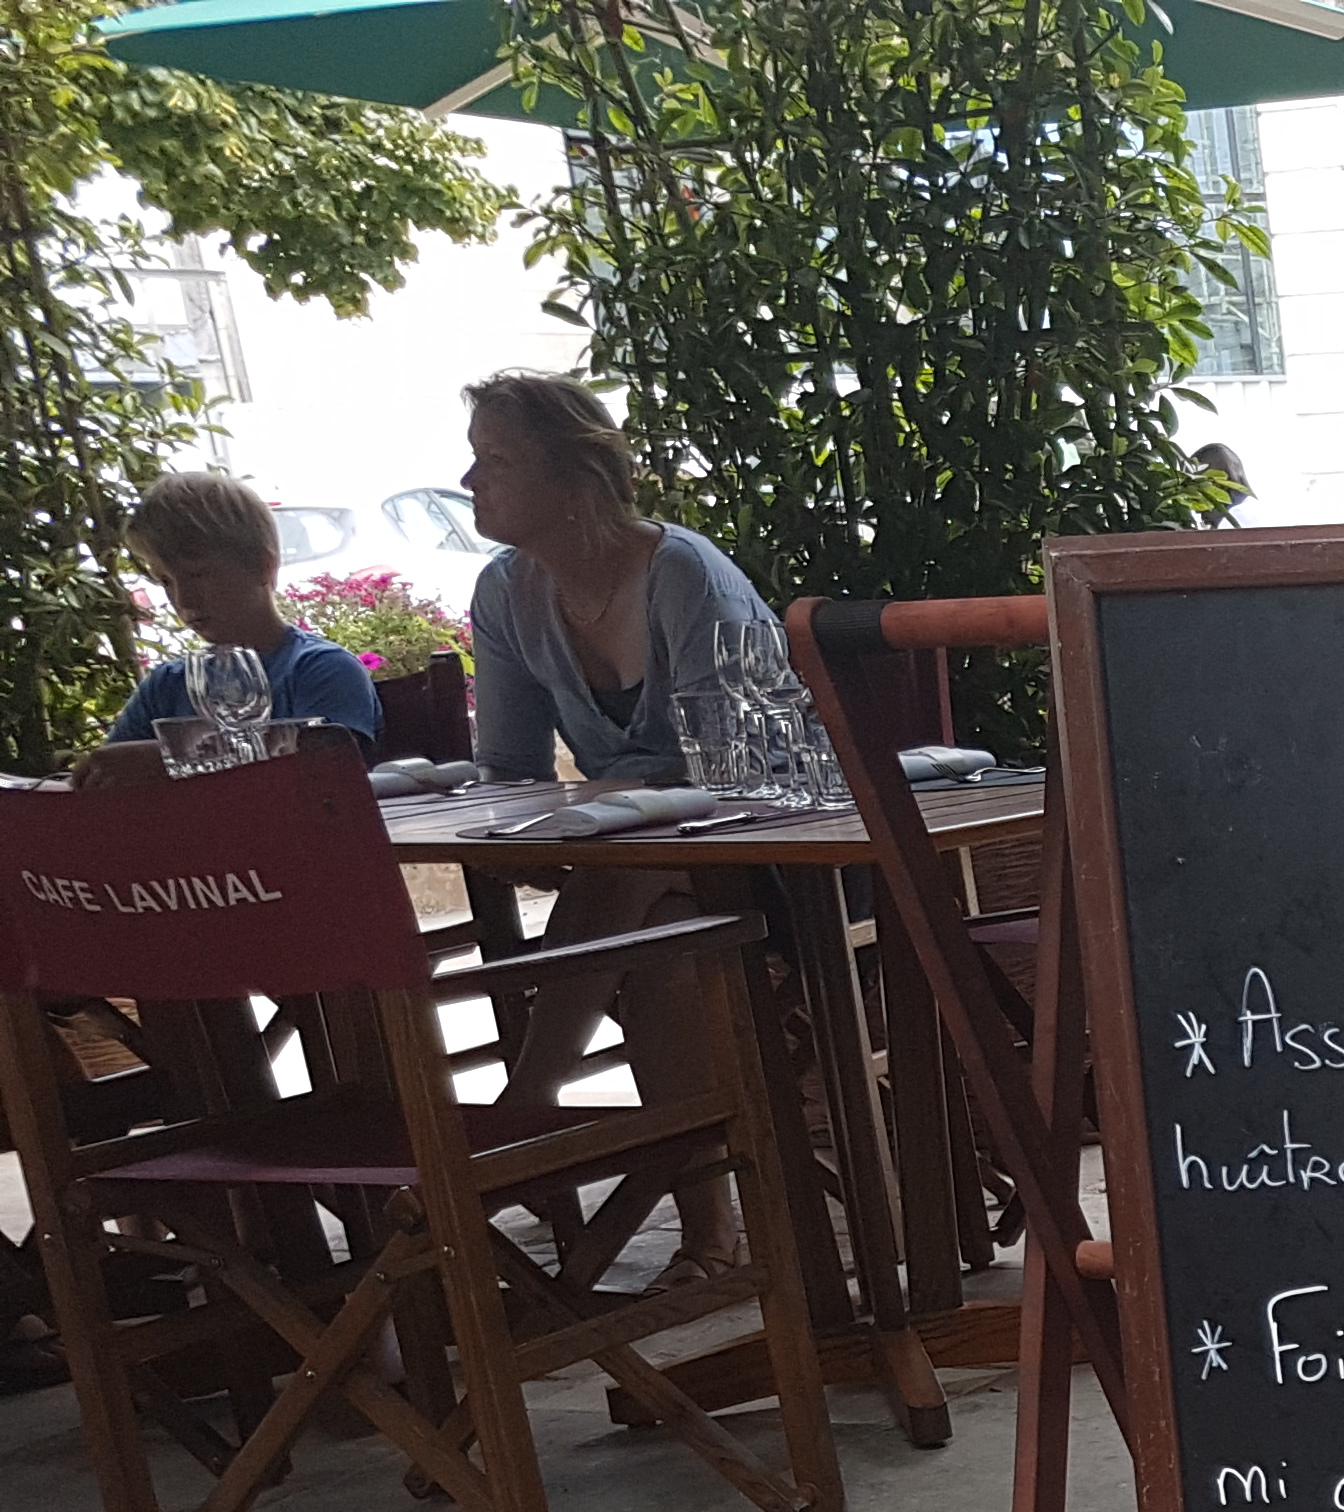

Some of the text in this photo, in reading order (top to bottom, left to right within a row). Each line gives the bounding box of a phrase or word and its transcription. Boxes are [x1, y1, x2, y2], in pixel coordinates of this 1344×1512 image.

[21, 869, 283, 913] CAFE LAVINAL
[1216, 1465, 1287, 1506] mi
